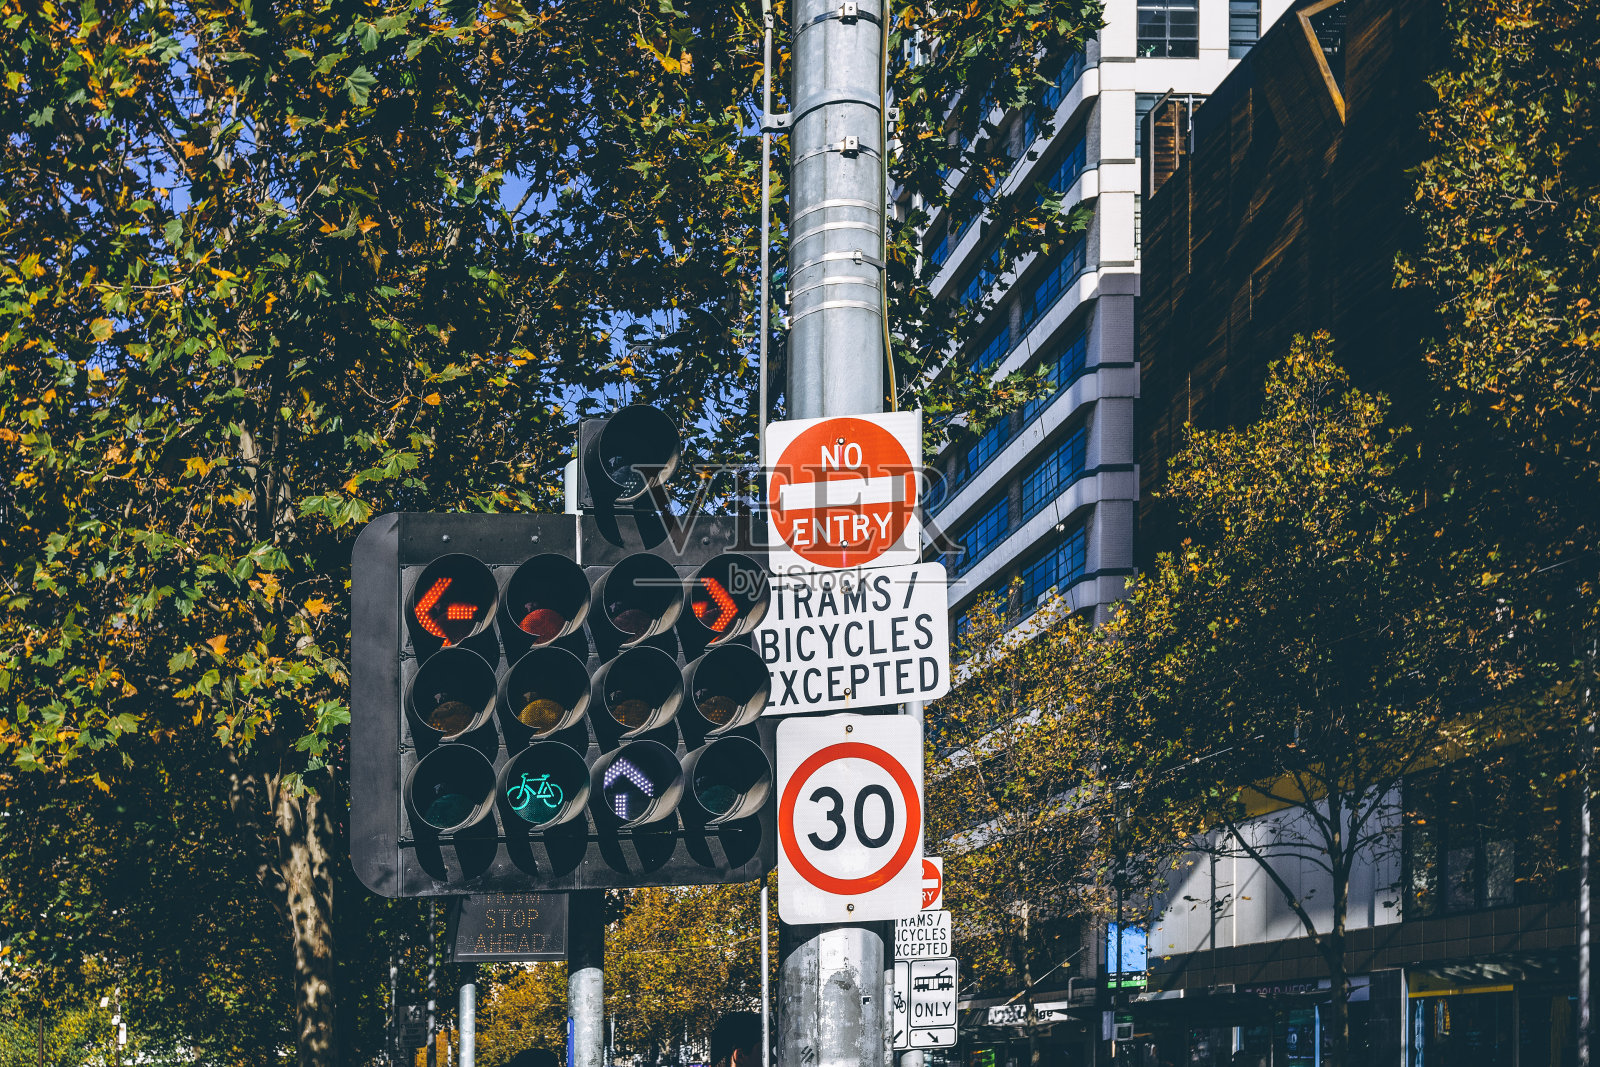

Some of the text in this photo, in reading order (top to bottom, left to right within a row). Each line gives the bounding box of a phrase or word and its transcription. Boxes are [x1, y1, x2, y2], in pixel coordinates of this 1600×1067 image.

[821, 443, 862, 472] NO
[793, 512, 893, 545] ENTRY
[772, 575, 891, 620] TRAMS
[760, 614, 933, 664] BICYCLES
[807, 784, 895, 851] 30
[486, 909, 538, 928] STOP
[474, 933, 546, 953] AHEAD
[895, 928, 946, 941] ICYCLES
[895, 943, 947, 956] XCEPTED
[915, 1001, 951, 1018] ONLY
